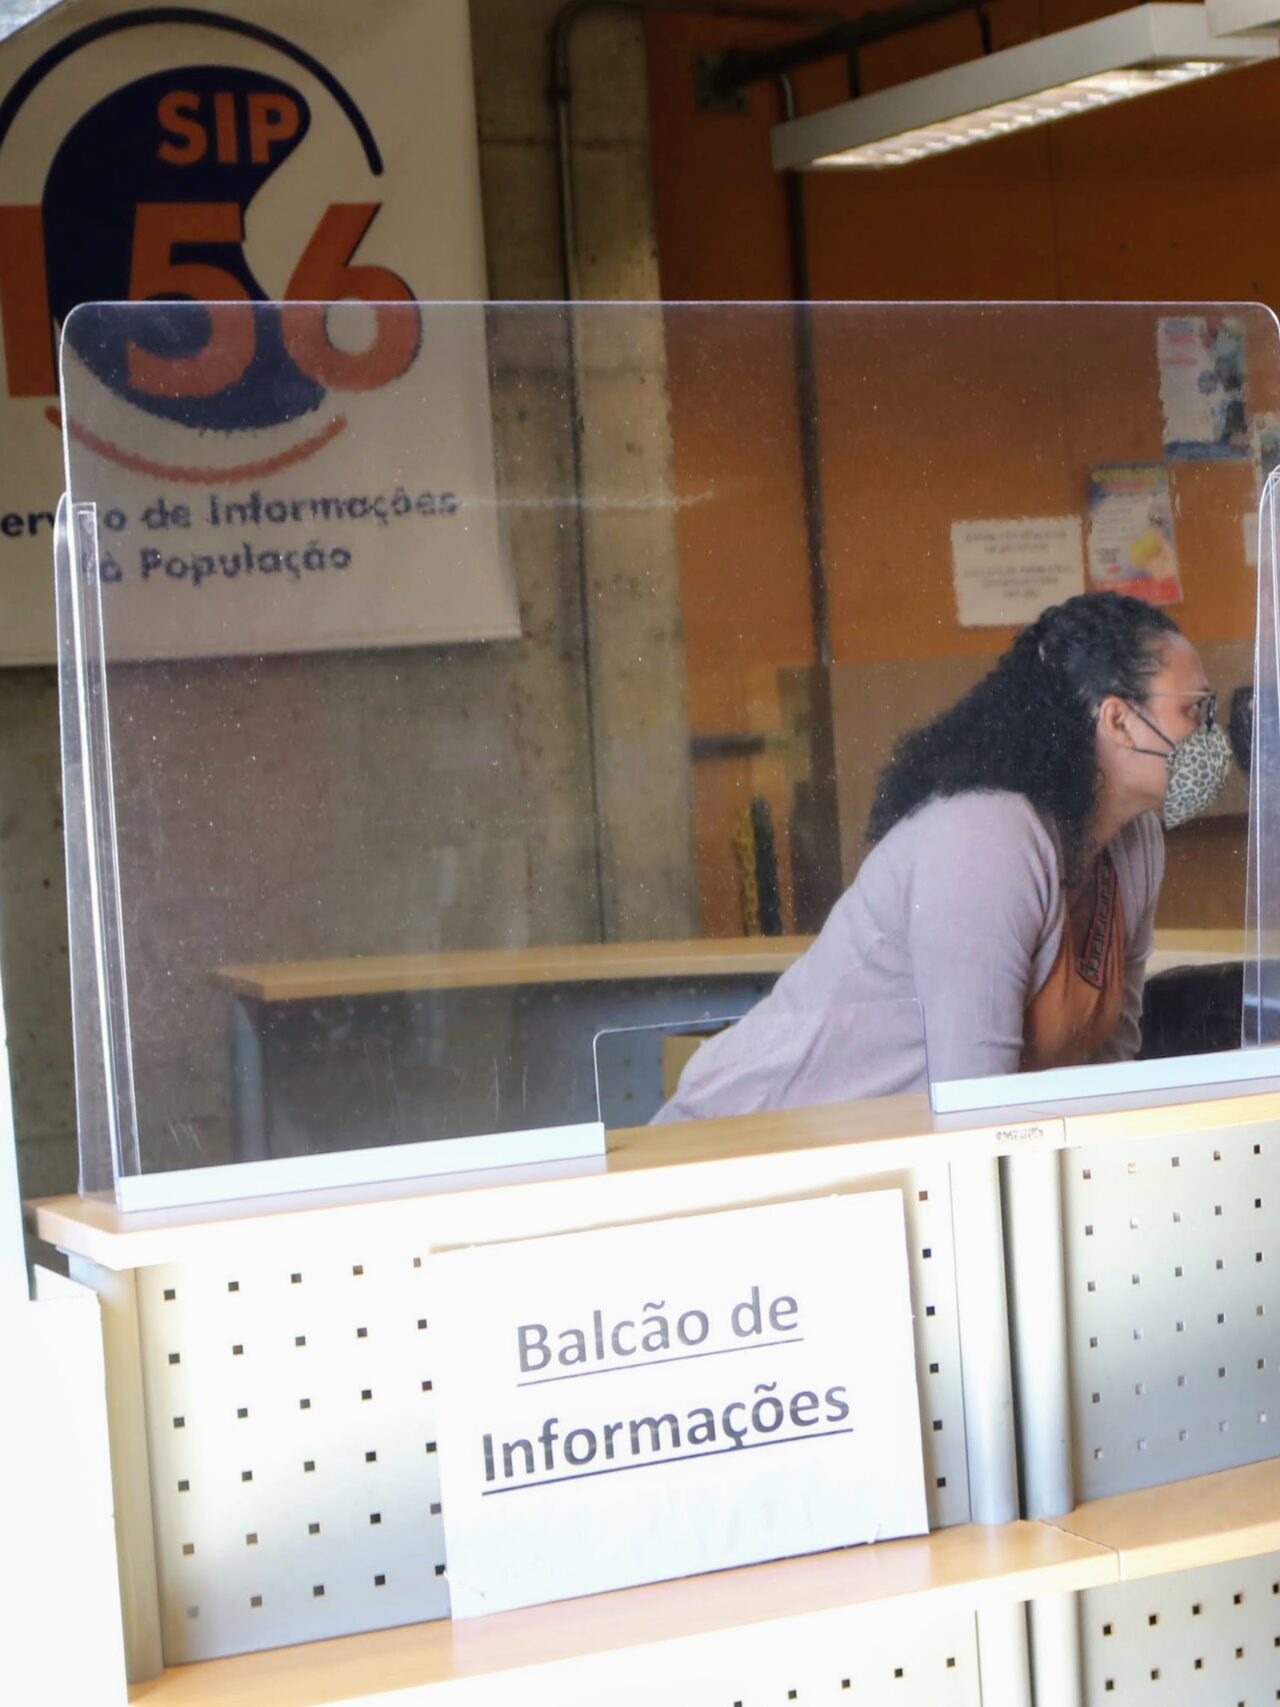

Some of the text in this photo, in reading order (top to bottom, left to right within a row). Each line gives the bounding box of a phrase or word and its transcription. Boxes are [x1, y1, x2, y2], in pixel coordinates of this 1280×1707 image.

[157, 90, 299, 165] SIP
[0, 201, 423, 398] 156
[142, 497, 191, 531] de
[210, 488, 458, 526] Informações
[140, 540, 352, 586] População
[516, 1285, 799, 1373] Balcão de
[482, 1381, 851, 1482] Informações
